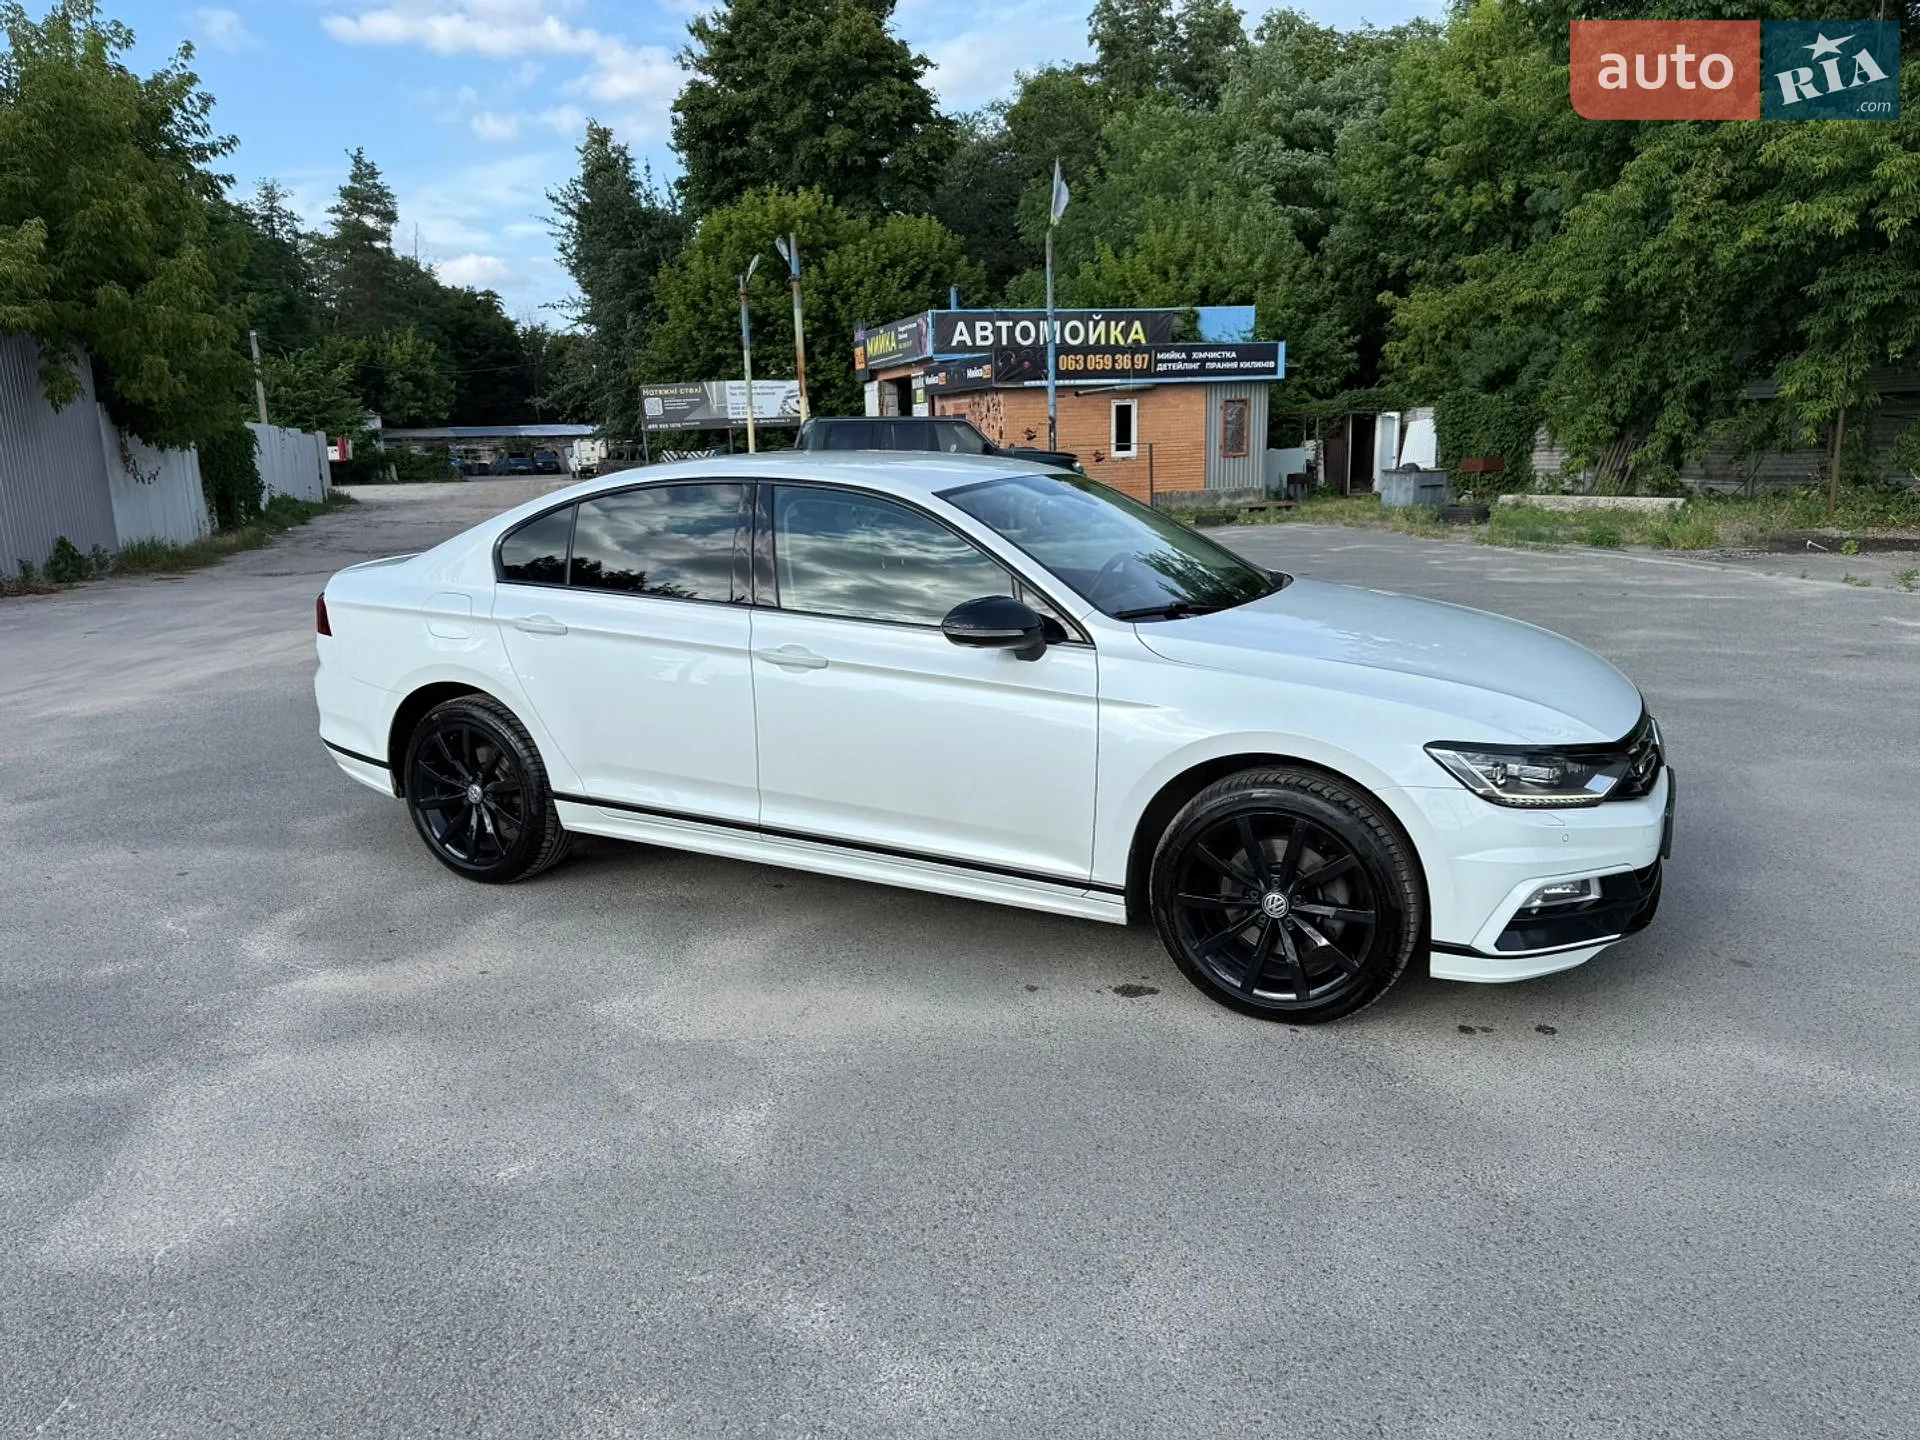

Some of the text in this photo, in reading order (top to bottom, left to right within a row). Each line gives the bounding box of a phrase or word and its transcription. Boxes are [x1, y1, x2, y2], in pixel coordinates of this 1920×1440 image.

[951, 314, 1147, 346] АВТОМОЙКА
[866, 328, 898, 358] МИЙКА
[1059, 353, 1149, 371] 063 059 36 97
[1156, 350, 1237, 360] МИЙКА ХІМЧИСТКА
[1156, 361, 1201, 371] ДЕТЕЙЛІНГ
[1205, 361, 1238, 369] ПРАННЯ
